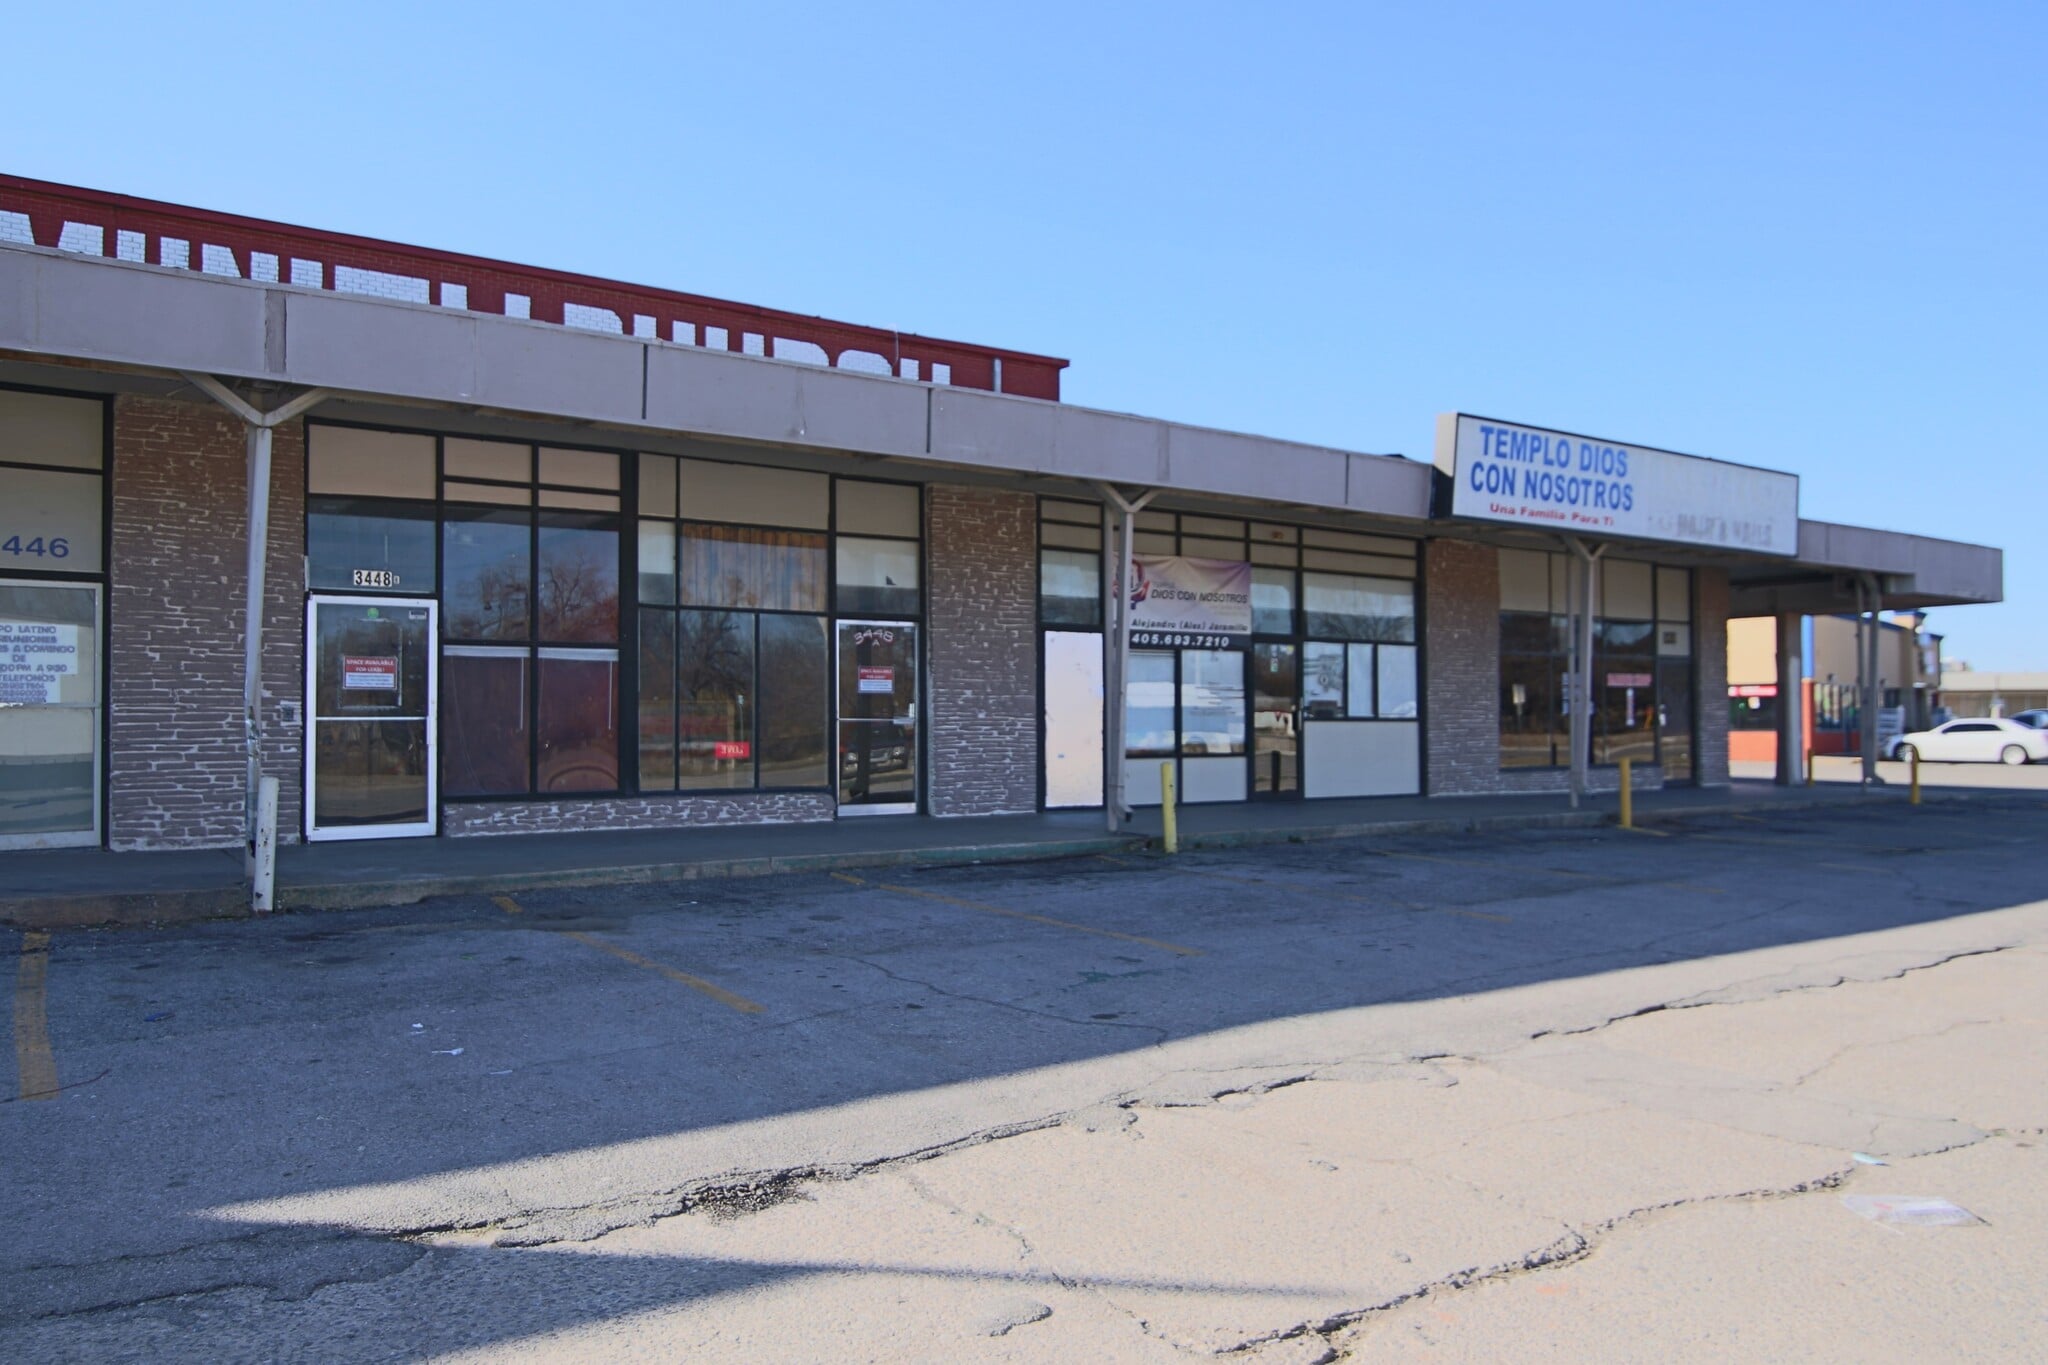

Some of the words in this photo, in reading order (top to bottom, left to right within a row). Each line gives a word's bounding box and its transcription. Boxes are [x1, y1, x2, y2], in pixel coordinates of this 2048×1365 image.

[1480, 425, 1570, 468] TEMPLO
[1580, 443, 1628, 478] DIOS
[1470, 461, 1516, 496] CON
[1524, 469, 1633, 512] NOSOTROS
[1490, 503, 1516, 515] Una
[1520, 506, 1566, 520] Familia
[1571, 512, 1599, 524] Para
[1604, 516, 1613, 526] Ti
[355, 570, 391, 587] 3448
[1151, 589, 1175, 600] DIOS
[1177, 591, 1196, 601] CON
[1199, 592, 1248, 604] NOSOTROS
[18, 625, 57, 634] LATINO
[854, 629, 894, 645] 3448
[1131, 633, 1230, 648] 405.693.7210
[12, 654, 26, 663] DE
